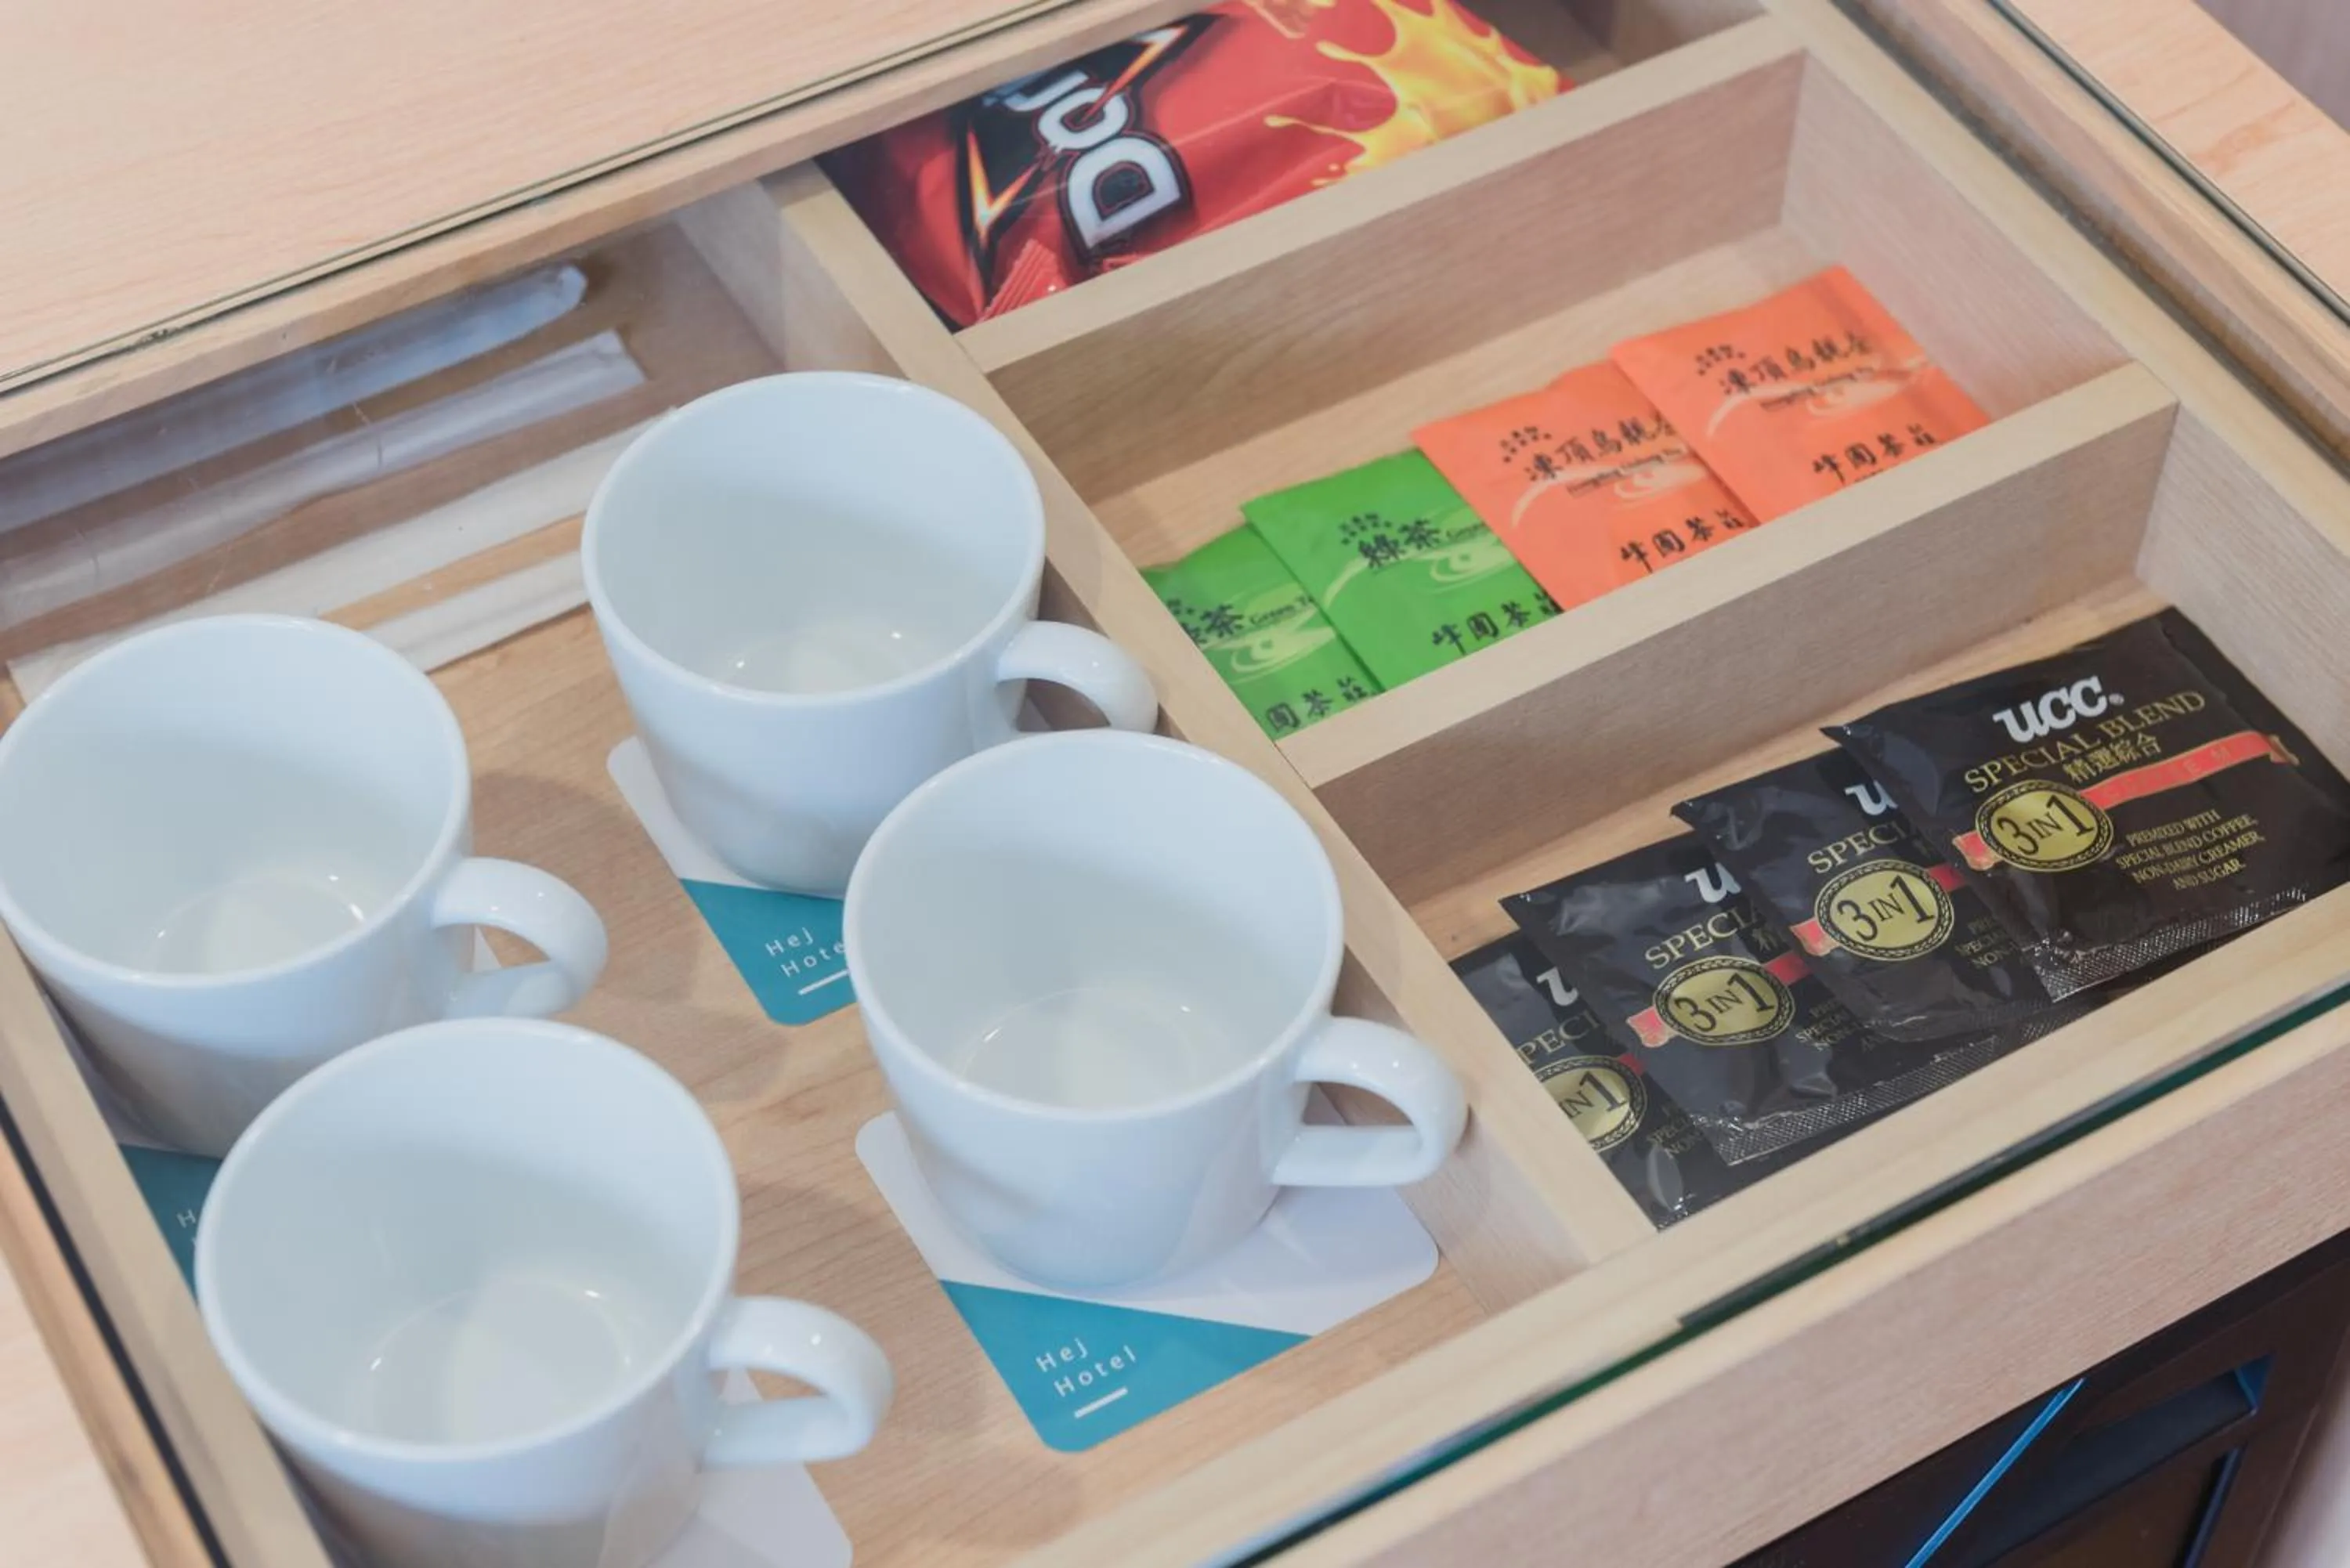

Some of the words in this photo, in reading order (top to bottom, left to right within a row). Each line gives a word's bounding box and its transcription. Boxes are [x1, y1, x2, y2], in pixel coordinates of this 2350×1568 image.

[1964, 733, 2101, 793] SPECIAL
[2097, 691, 2205, 739] BLEND
[2063, 732, 2162, 783] 精選綜合
[1997, 817, 2039, 855] 3
[2027, 811, 2063, 839] IN
[2046, 795, 2095, 836] 1
[2183, 809, 2222, 830] WITH
[1807, 822, 1907, 874] SPECI
[2116, 846, 2165, 870] SPECIAL
[1837, 900, 1878, 941] 3
[1867, 893, 1904, 922] IN
[1889, 875, 1935, 919] 1
[765, 927, 814, 957] Hej
[780, 941, 845, 978] Hote
[1645, 906, 1757, 970] SPECI
[1674, 996, 1716, 1032] 3
[1705, 989, 1743, 1013] IN
[1727, 973, 1774, 1013] 1
[1517, 1010, 1600, 1065] PECI
[1579, 1071, 1628, 1111] 1
[1035, 1337, 1089, 1372] Hej
[1053, 1345, 1136, 1397] Hotel
